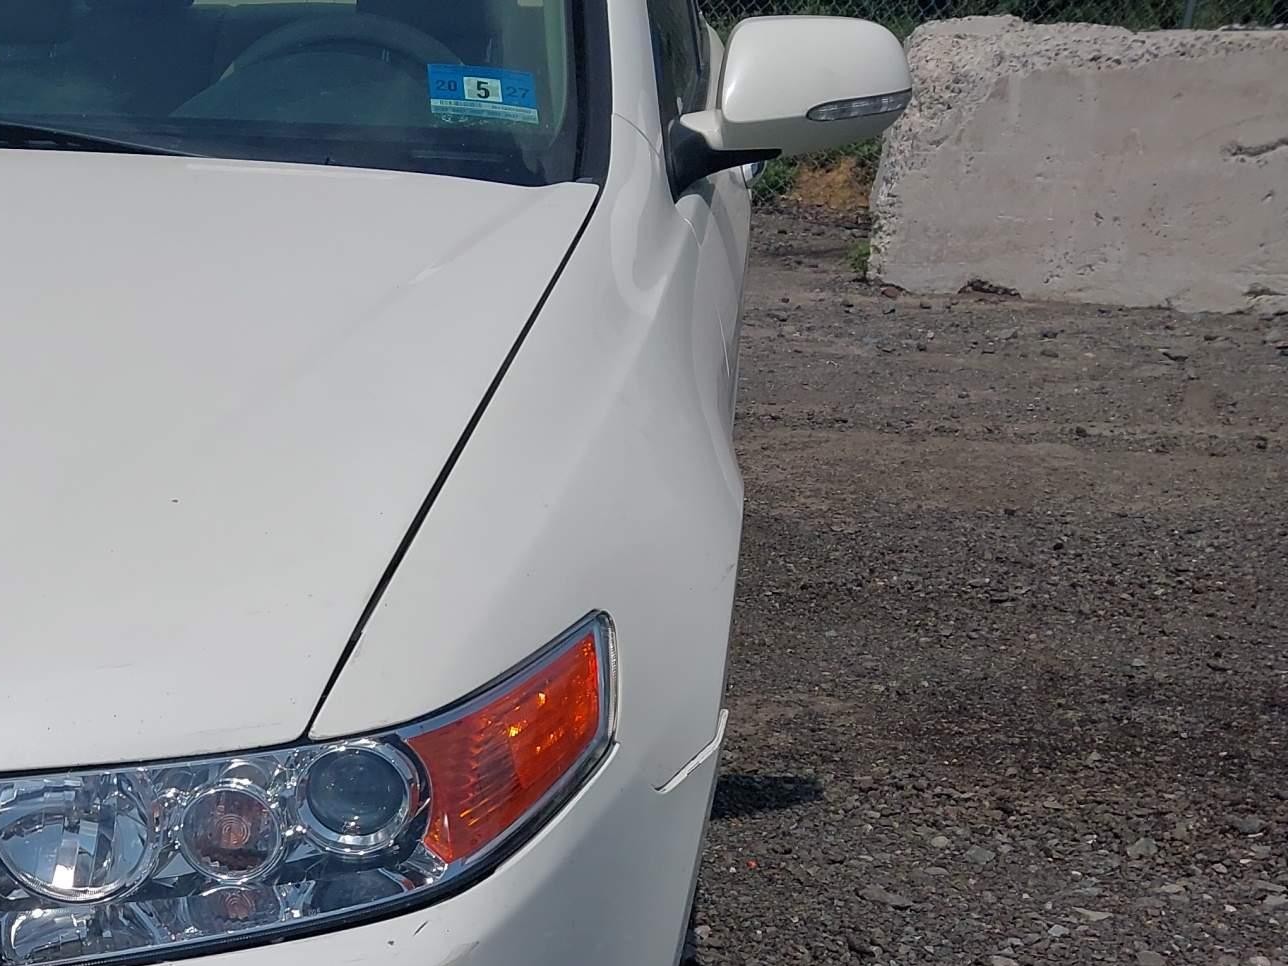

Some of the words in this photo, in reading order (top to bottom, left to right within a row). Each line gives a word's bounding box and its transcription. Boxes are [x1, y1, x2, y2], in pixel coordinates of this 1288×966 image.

[435, 80, 458, 92] 20
[476, 80, 490, 99] 5
[505, 85, 529, 99] 27
